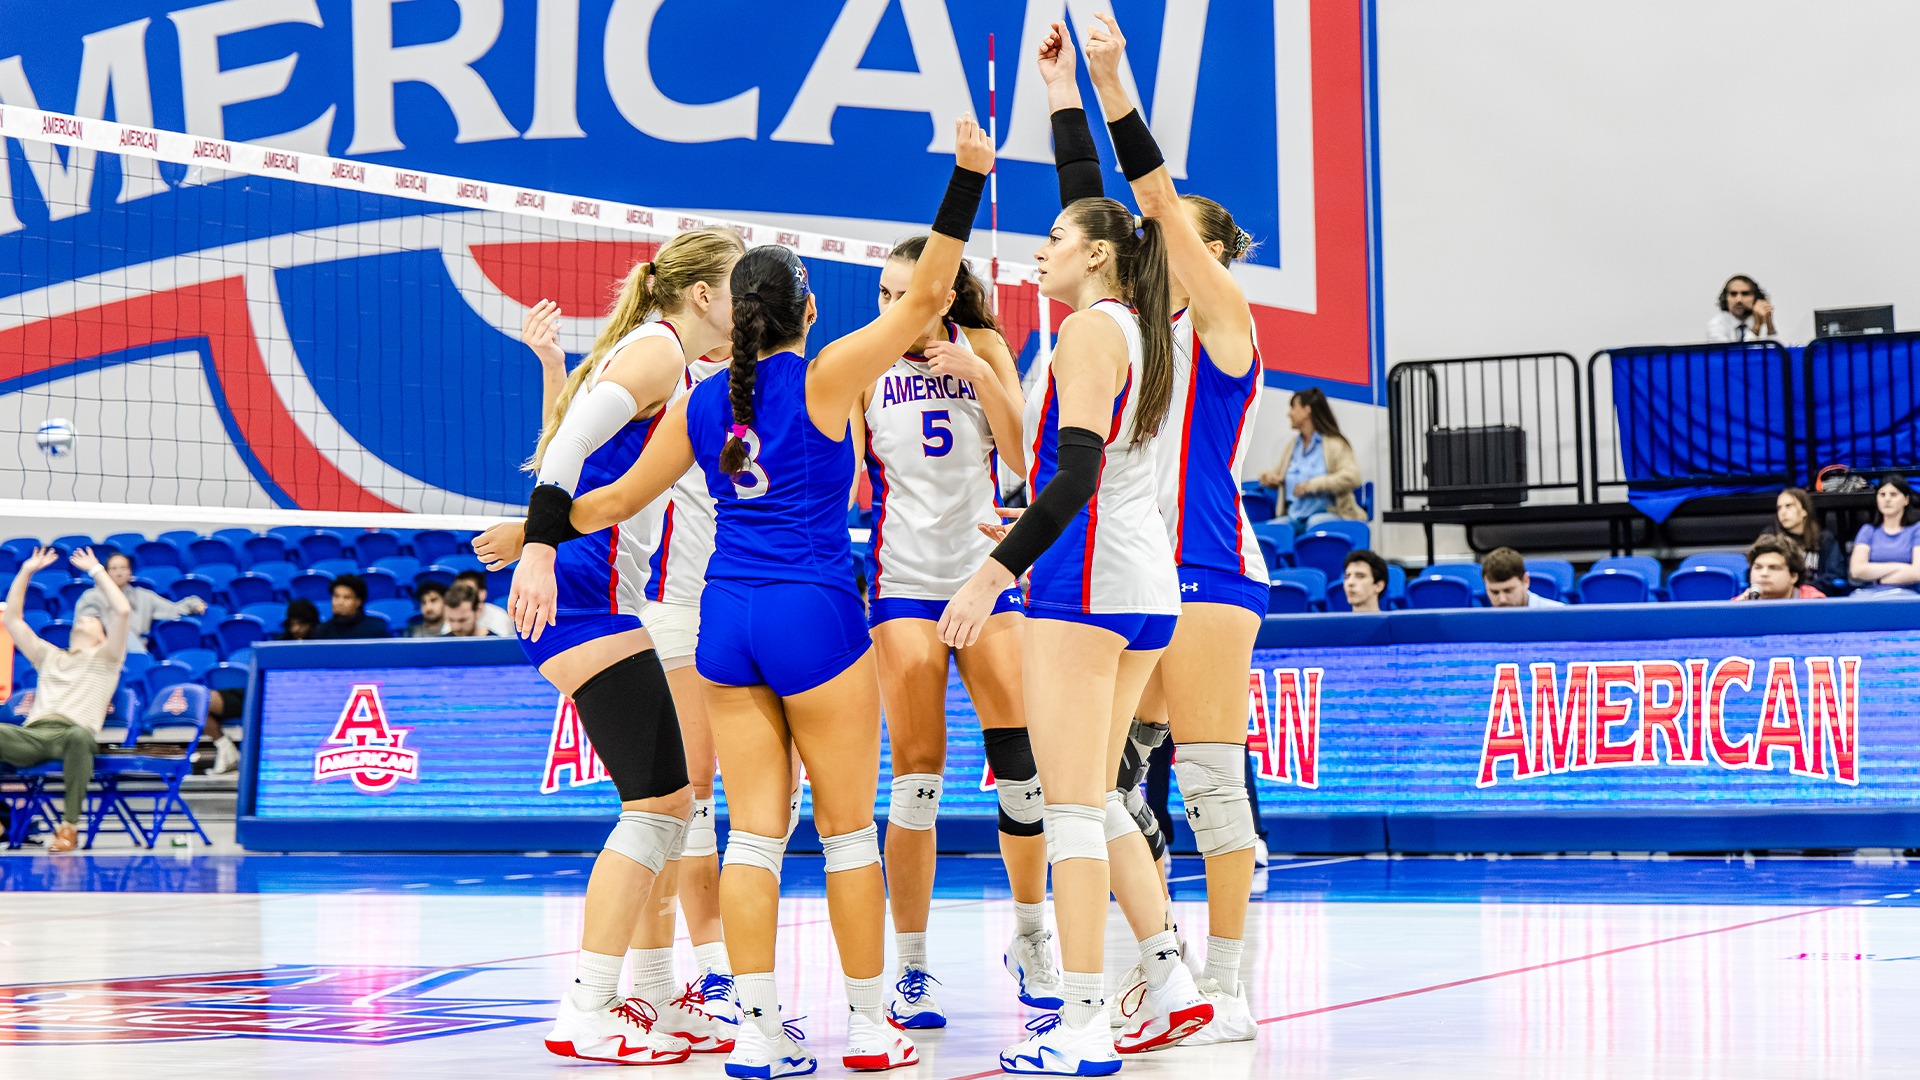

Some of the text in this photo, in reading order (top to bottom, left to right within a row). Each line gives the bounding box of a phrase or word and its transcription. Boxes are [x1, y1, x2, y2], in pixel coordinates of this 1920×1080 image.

[41, 115, 83, 140] AMERICAN
[119, 129, 158, 151] AMERICAN
[192, 140, 231, 163] AMERICAN
[262, 152, 299, 174] AMERICAN
[330, 162, 365, 184] AMERICAN
[395, 172, 427, 193] AMERICAN
[456, 182, 488, 202] AMERICAN
[515, 192, 545, 211] AMERICAN
[571, 200, 600, 218] AMERICAN
[626, 209, 653, 227] AMERICAN
[921, 410, 953, 458] 5
[1476, 656, 1862, 788] AMERICAN
[320, 751, 413, 773] AMERICAN
